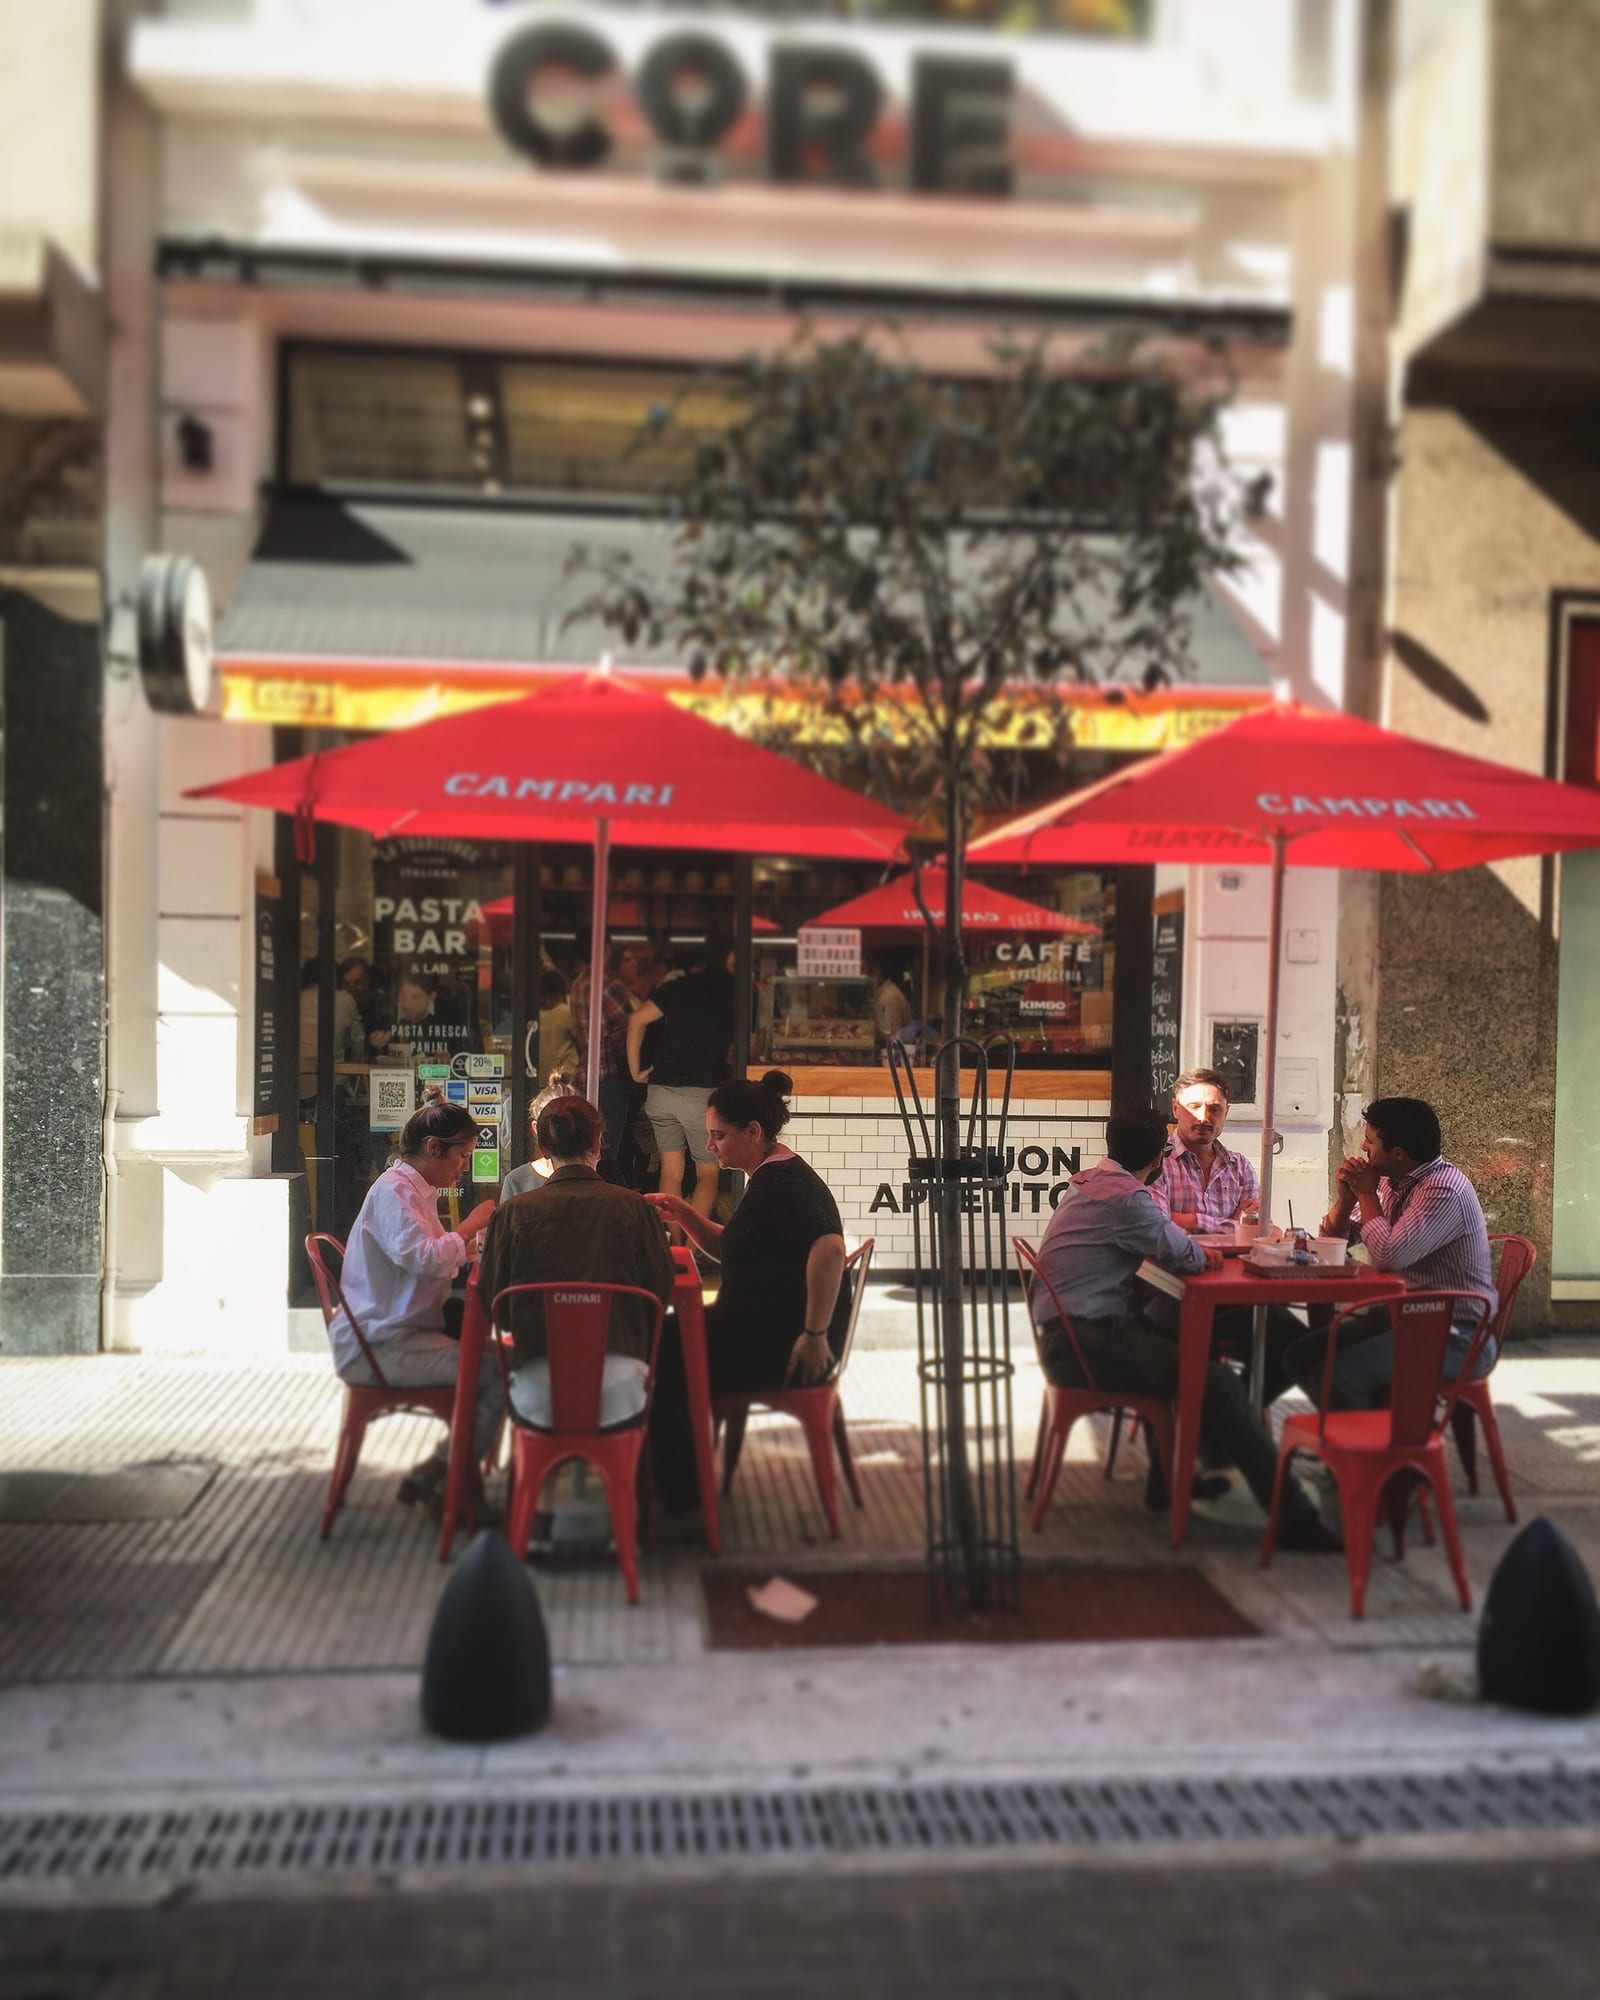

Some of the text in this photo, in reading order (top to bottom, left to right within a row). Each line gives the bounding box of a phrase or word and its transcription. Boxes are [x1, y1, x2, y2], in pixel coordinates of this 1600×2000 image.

[489, 21, 1017, 197] CORE
[443, 773, 676, 806] CAMPARI
[1256, 794, 1478, 821] CAMPARI
[374, 898, 486, 924] PASTA
[393, 929, 467, 955] BAR
[423, 963, 449, 974] LAB
[1019, 1000, 1066, 1010] KIMBO
[391, 1025, 468, 1037] PASTA FRESCA
[410, 1040, 449, 1053] PANINI
[474, 1086, 498, 1095] VISA
[474, 1106, 497, 1115] VISA
[553, 1292, 602, 1304] CAMPARI
[1402, 1301, 1446, 1314] CAMPARI
